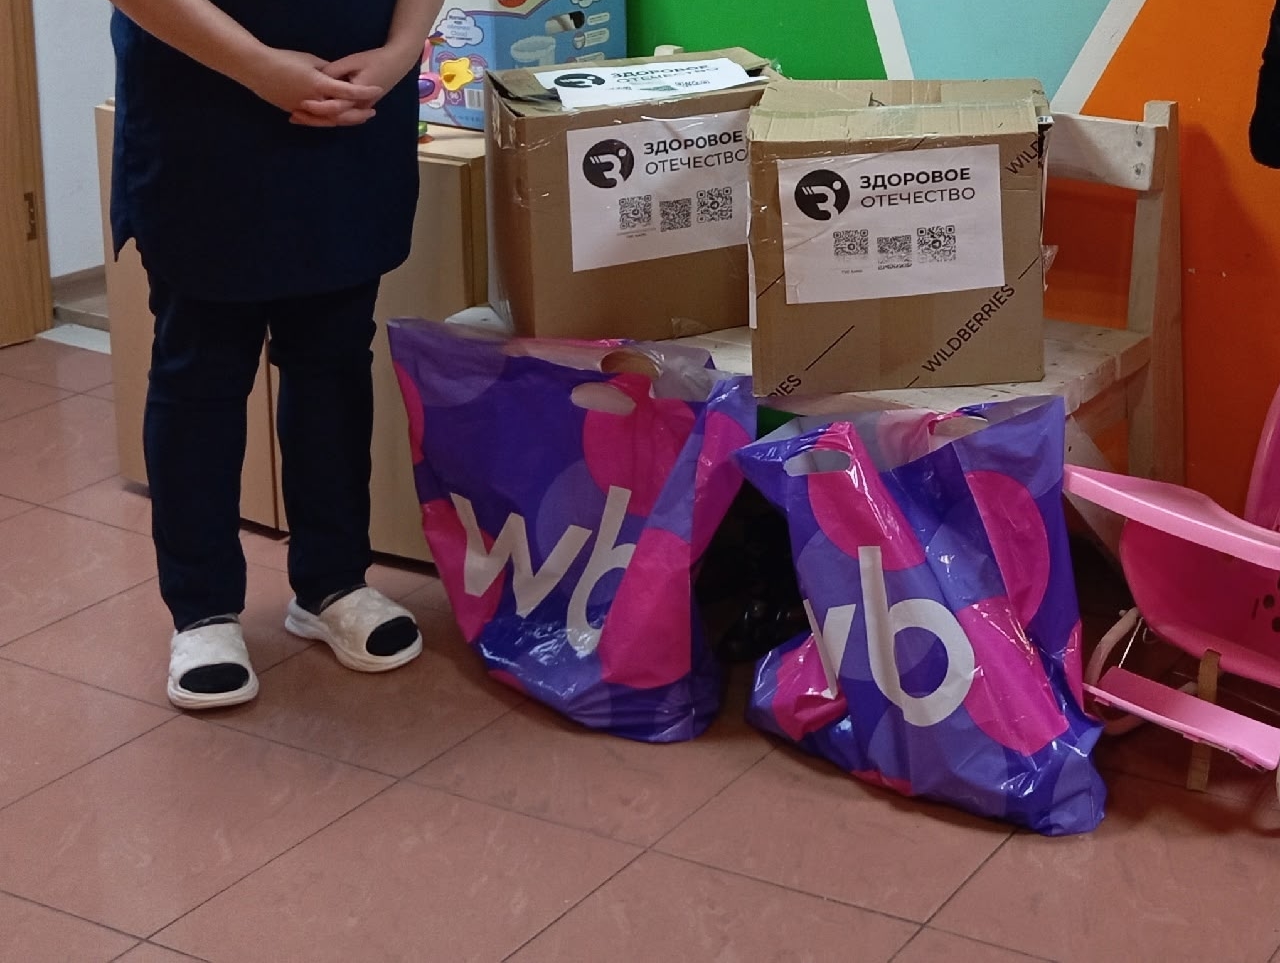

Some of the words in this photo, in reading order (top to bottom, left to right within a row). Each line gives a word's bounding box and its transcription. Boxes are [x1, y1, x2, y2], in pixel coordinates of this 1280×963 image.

[643, 130, 743, 156] ЗДОРОВОЕ
[645, 149, 748, 175] ОТЕЧЕСТВО
[860, 167, 971, 190] ЗДОРОВОЕ
[860, 187, 976, 208] ОТЕЧЕСТВО
[922, 284, 1016, 374] WILDBERRIES
